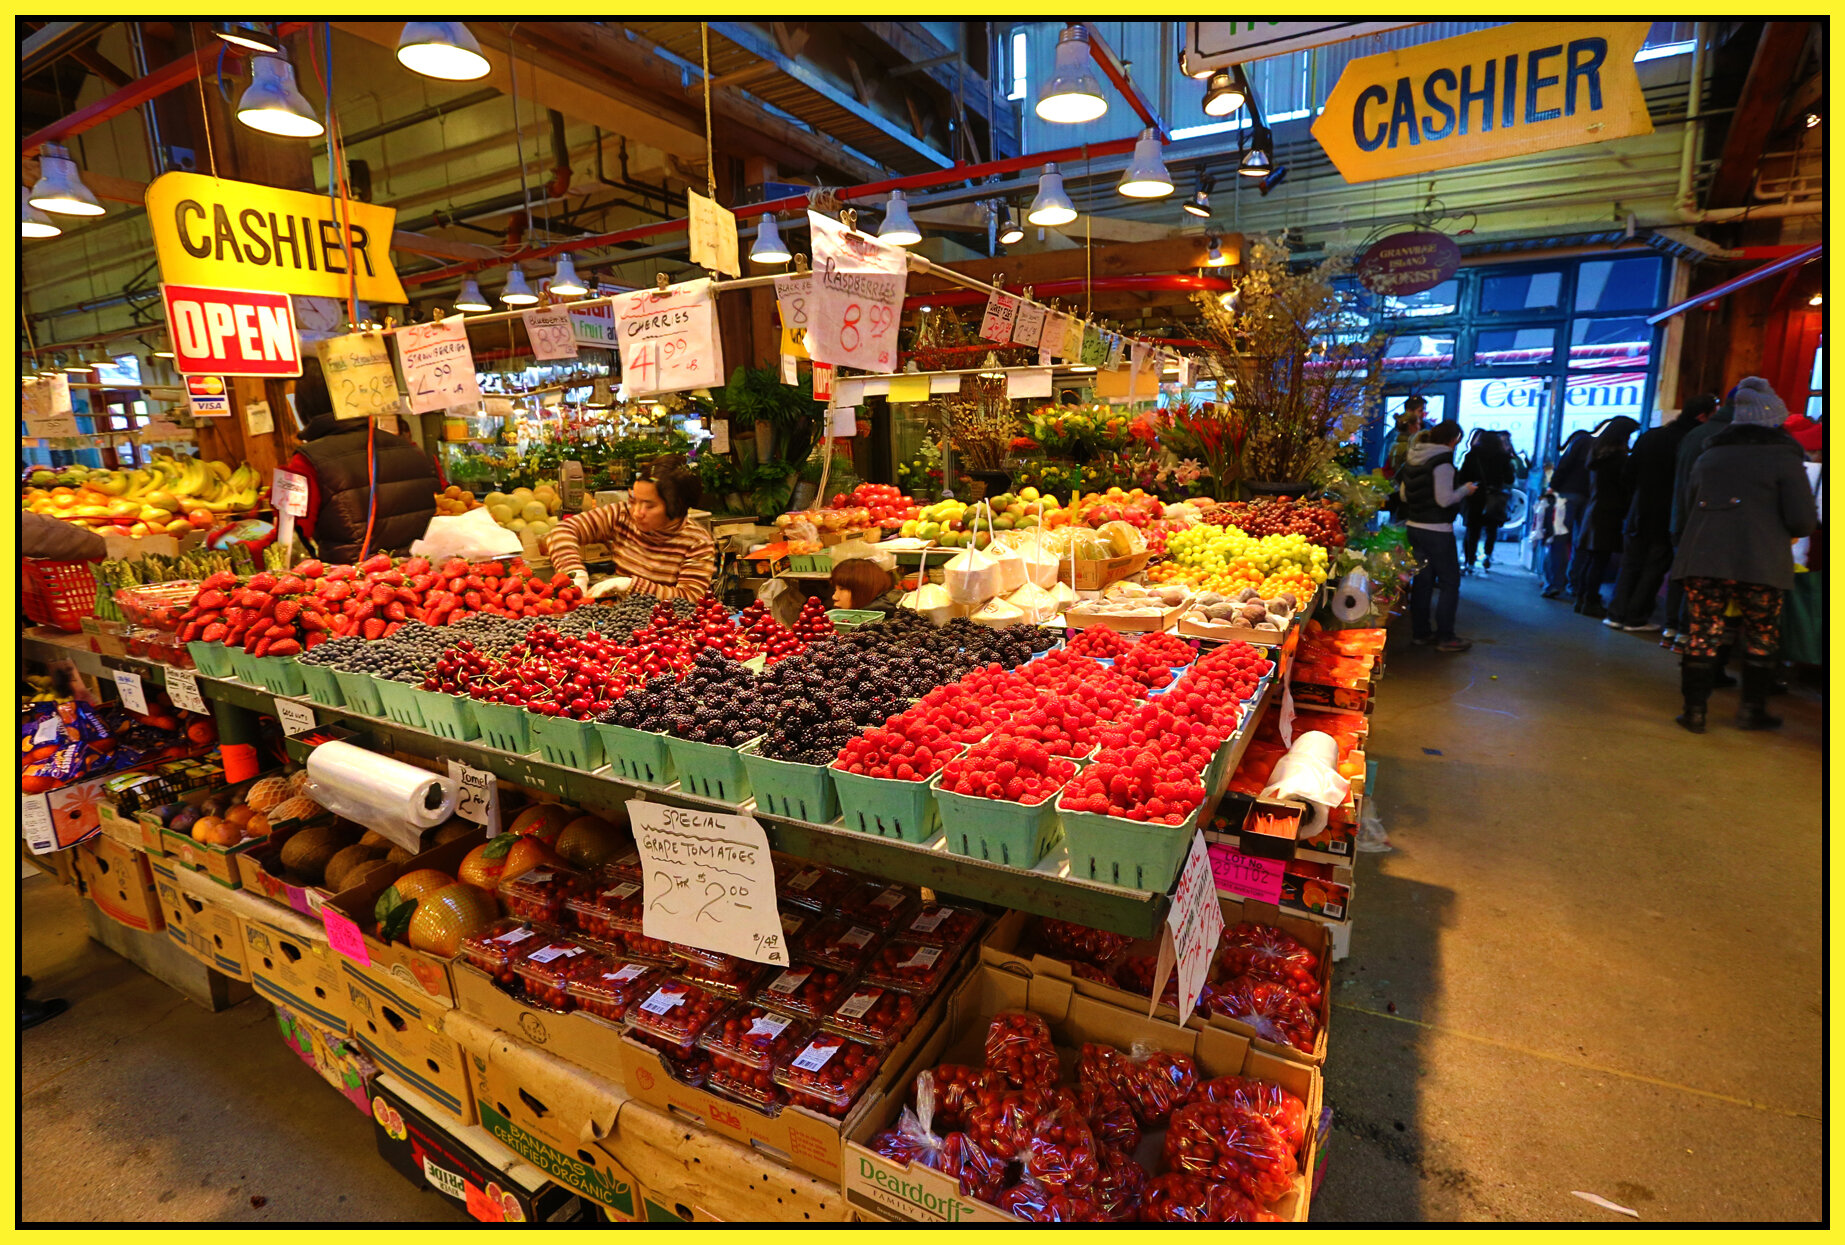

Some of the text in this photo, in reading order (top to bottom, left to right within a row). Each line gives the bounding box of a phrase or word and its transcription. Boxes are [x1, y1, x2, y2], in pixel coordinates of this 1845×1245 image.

[1352, 37, 1608, 152] CASHIER
[175, 199, 376, 277] CASHIER
[172, 301, 295, 362] OPEN
[627, 312, 689, 337] CHERRIES
[198, 402, 222, 410] VISA
[458, 786, 472, 815] 2
[663, 809, 726, 830] SPECIAL
[643, 835, 756, 865] GRAPE TOMATOES
[1225, 852, 1265, 871] LOT No.
[1213, 861, 1270, 884] 291102
[650, 871, 680, 915] 2
[708, 1104, 742, 1130] Dole
[494, 1125, 549, 1169] CERTIFIED
[551, 1164, 613, 1204] ORGANIC
[509, 1124, 586, 1176] BANANAS
[427, 1162, 465, 1193] PRIDE
[859, 1157, 964, 1223] Deardorff
[872, 1189, 914, 1214] FAMILY
